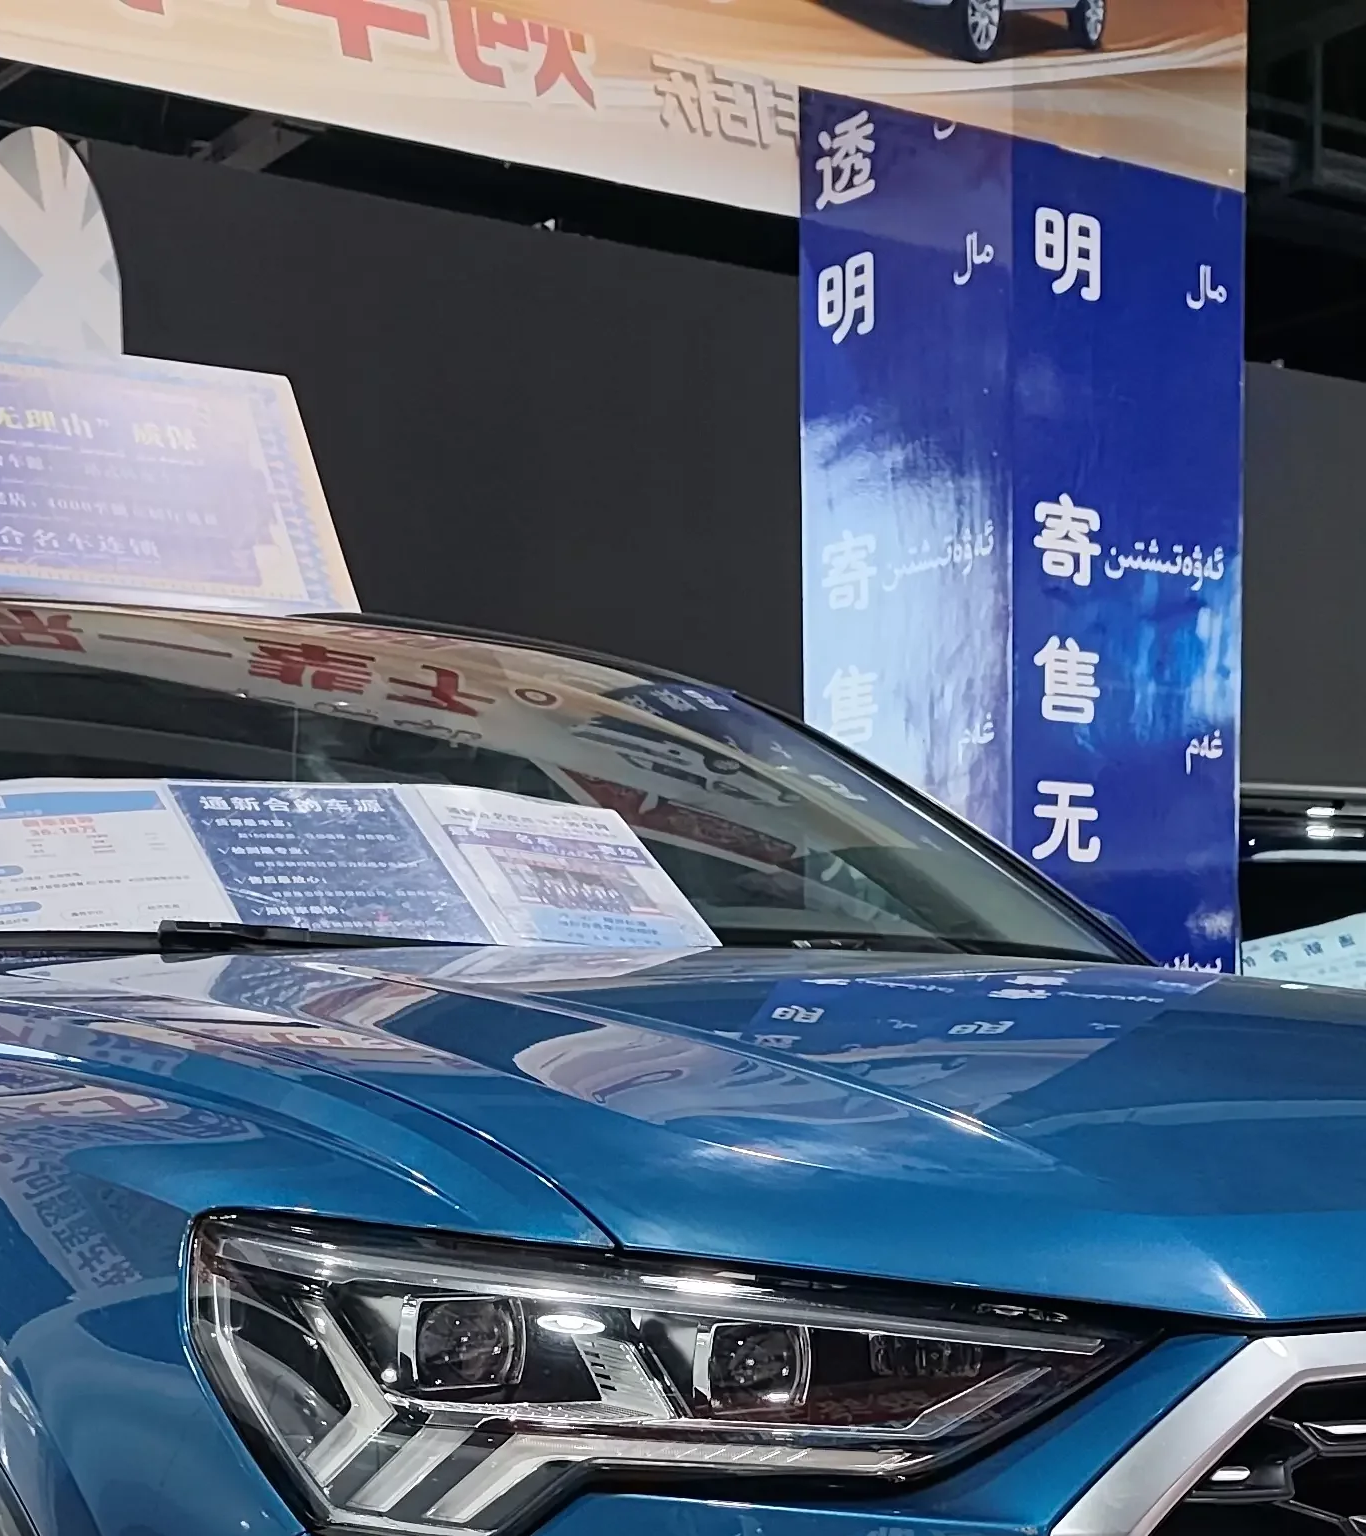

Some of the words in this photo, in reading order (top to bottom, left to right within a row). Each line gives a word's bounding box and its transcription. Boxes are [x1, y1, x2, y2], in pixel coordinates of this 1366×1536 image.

[815, 109, 876, 345] 透明
[1035, 207, 1102, 302] 明
[1186, 265, 1228, 310] مال
[1032, 493, 1103, 864] 寄售无
[199, 795, 387, 814] 通新合的车源
